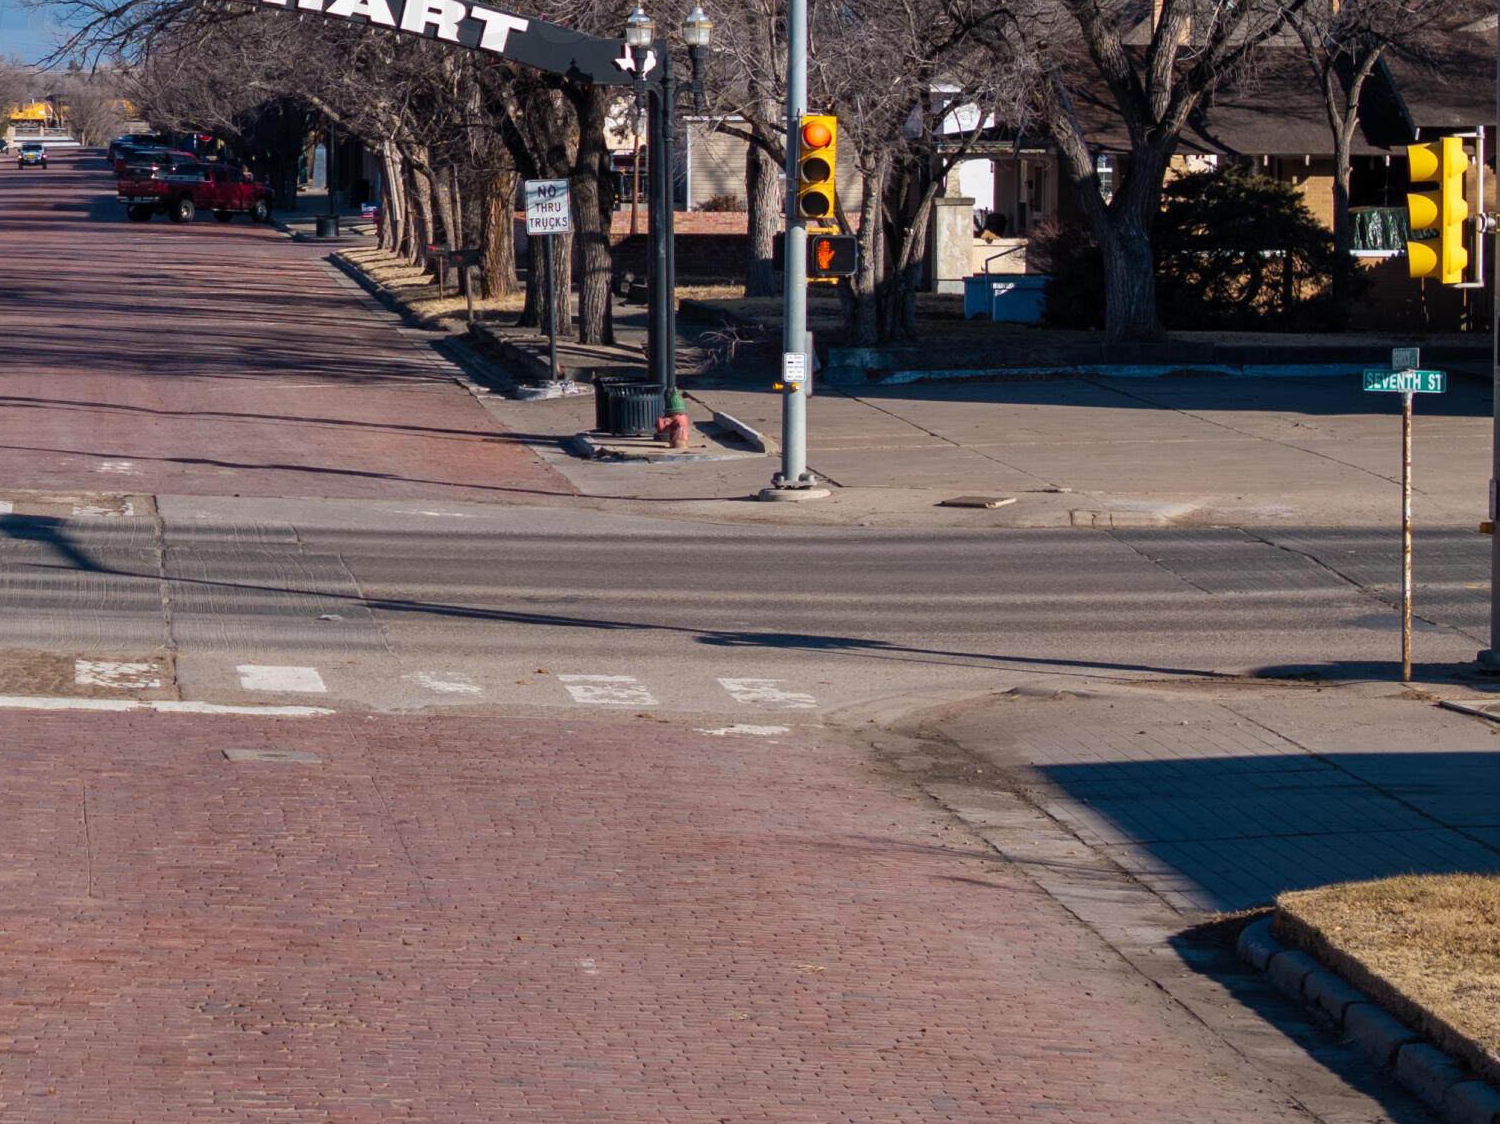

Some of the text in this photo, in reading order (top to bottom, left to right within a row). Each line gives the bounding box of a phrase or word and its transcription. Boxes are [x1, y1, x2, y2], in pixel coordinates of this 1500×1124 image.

[537, 184, 556, 198] NO
[535, 202, 560, 213] THRU
[529, 217, 568, 228] TRUCKS
[1367, 372, 1442, 390] SEVENTH ST
